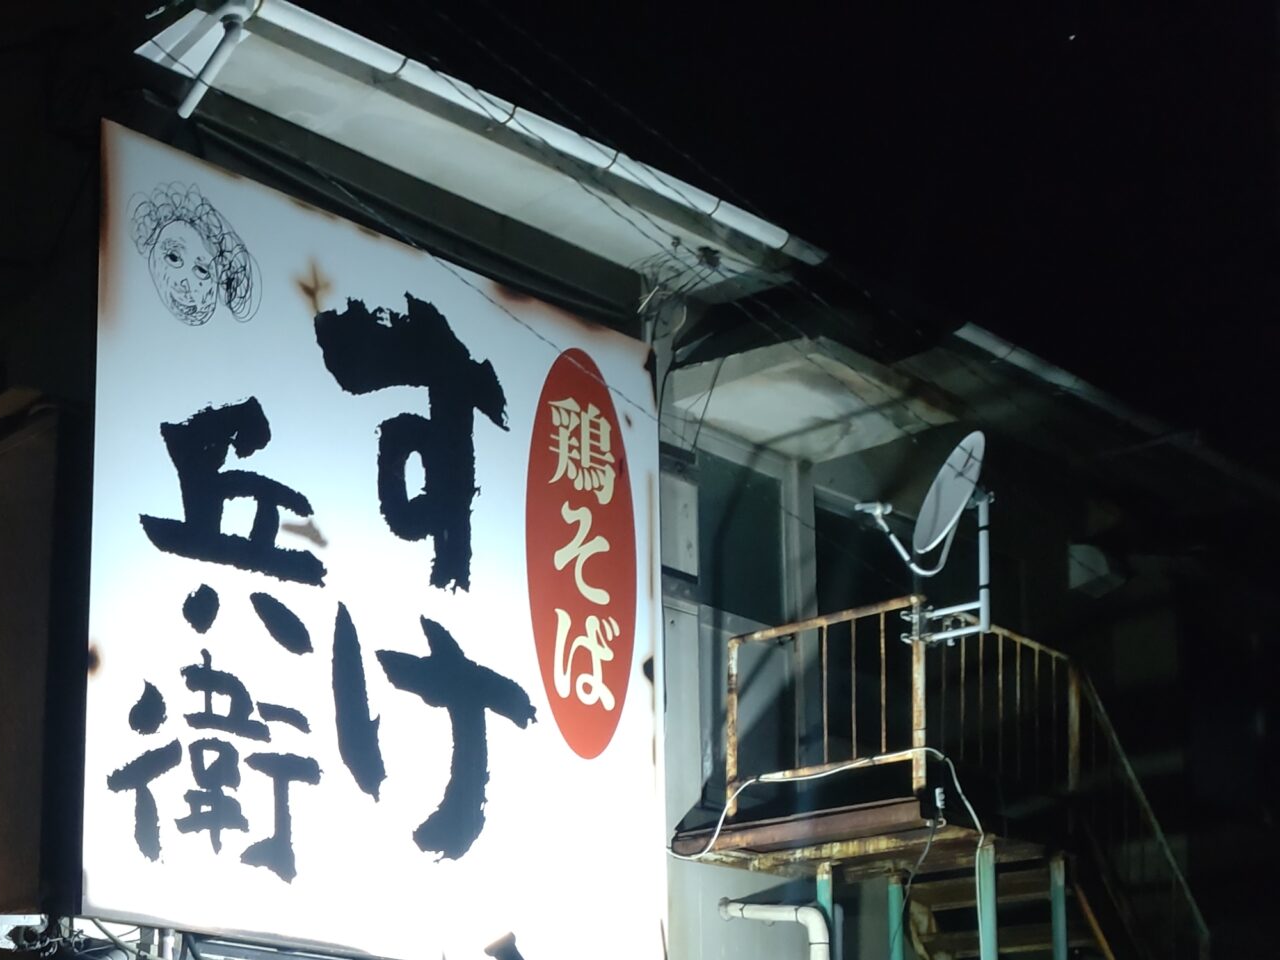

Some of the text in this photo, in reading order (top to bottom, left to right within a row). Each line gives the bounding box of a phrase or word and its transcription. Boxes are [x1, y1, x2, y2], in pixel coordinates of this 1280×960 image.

[106, 396, 326, 884] 兵衛
[314, 290, 537, 862] すけ
[547, 397, 620, 712] 鶏そば
